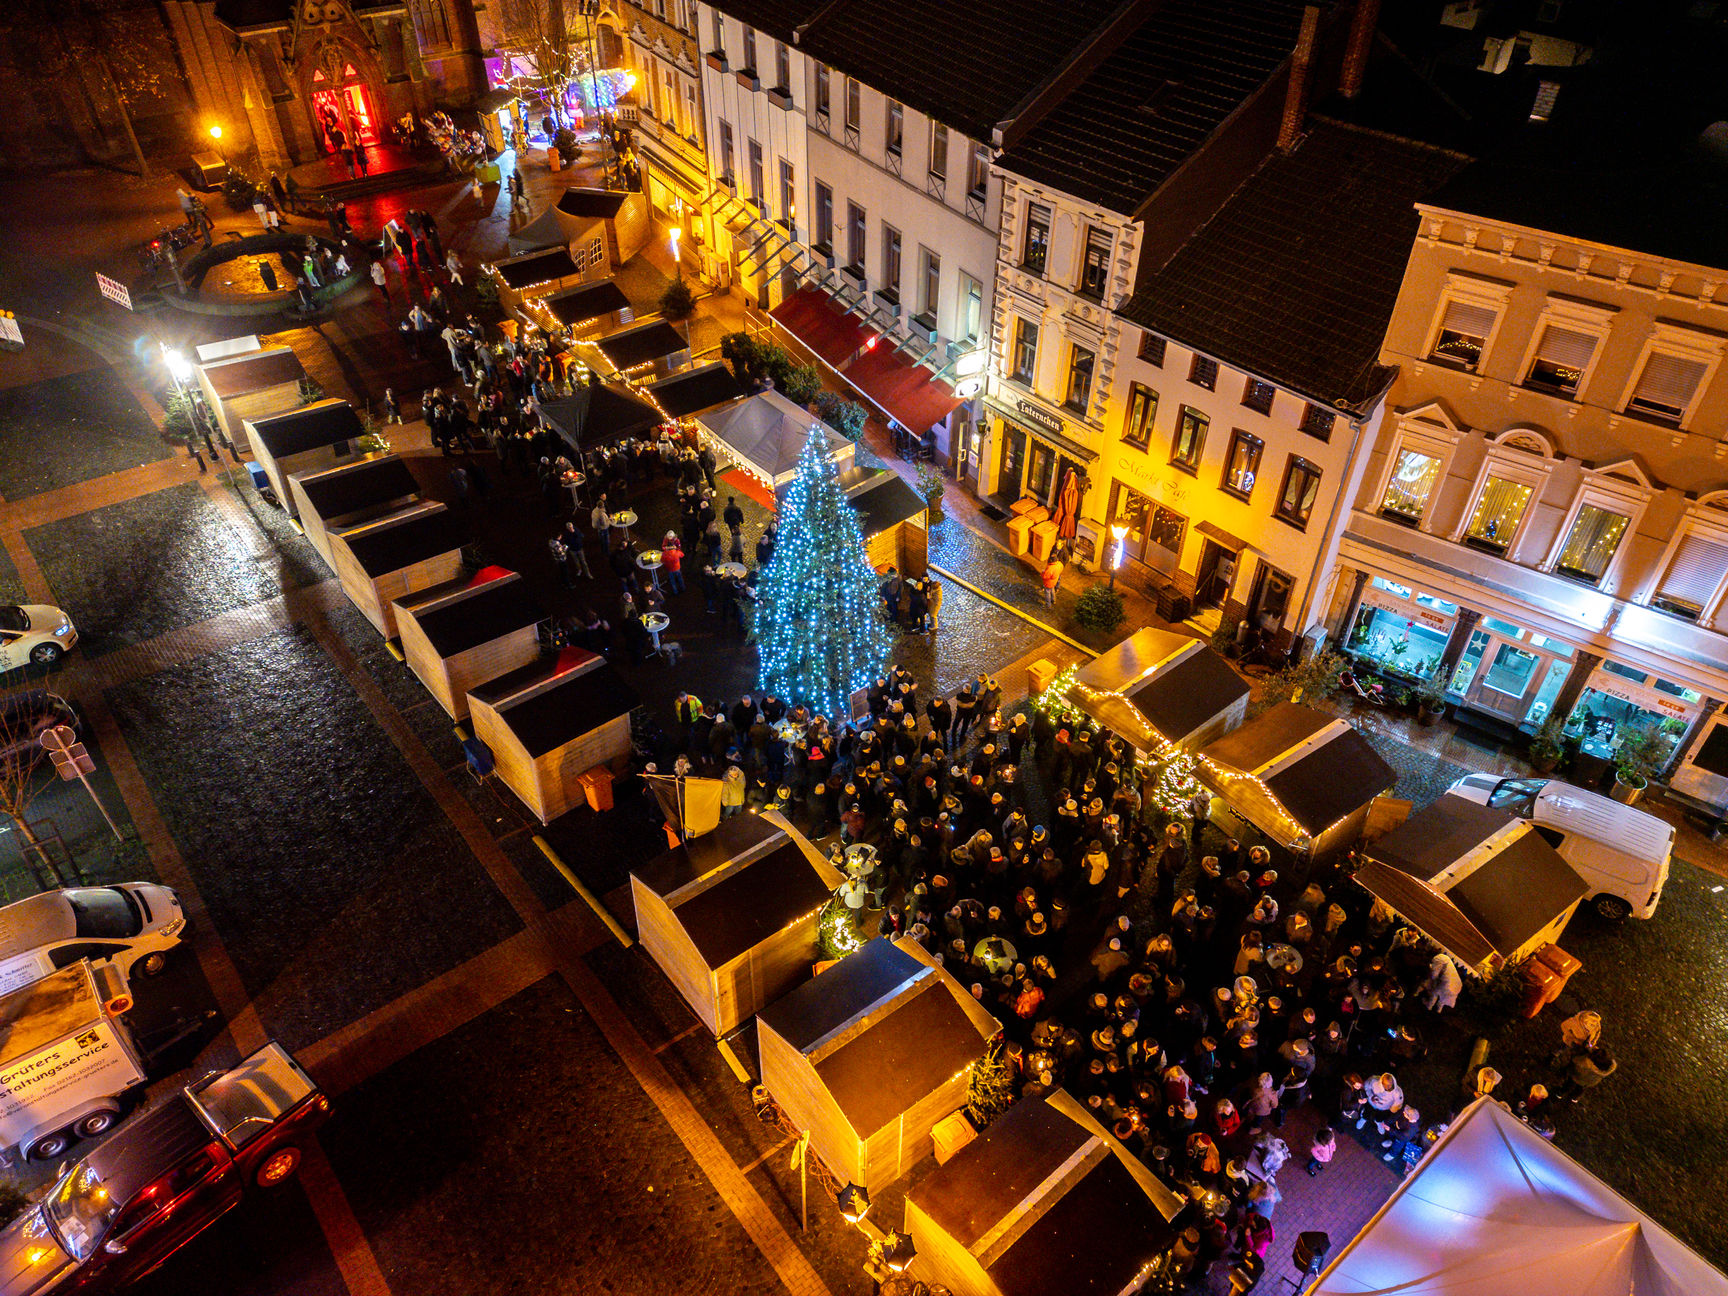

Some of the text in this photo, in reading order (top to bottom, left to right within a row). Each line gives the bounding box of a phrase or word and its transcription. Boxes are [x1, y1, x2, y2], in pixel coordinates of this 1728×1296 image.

[1378, 602, 1398, 614] PIZZA
[1606, 688, 1630, 700] PIZZA
[0, 1052, 61, 1085] Grüters
